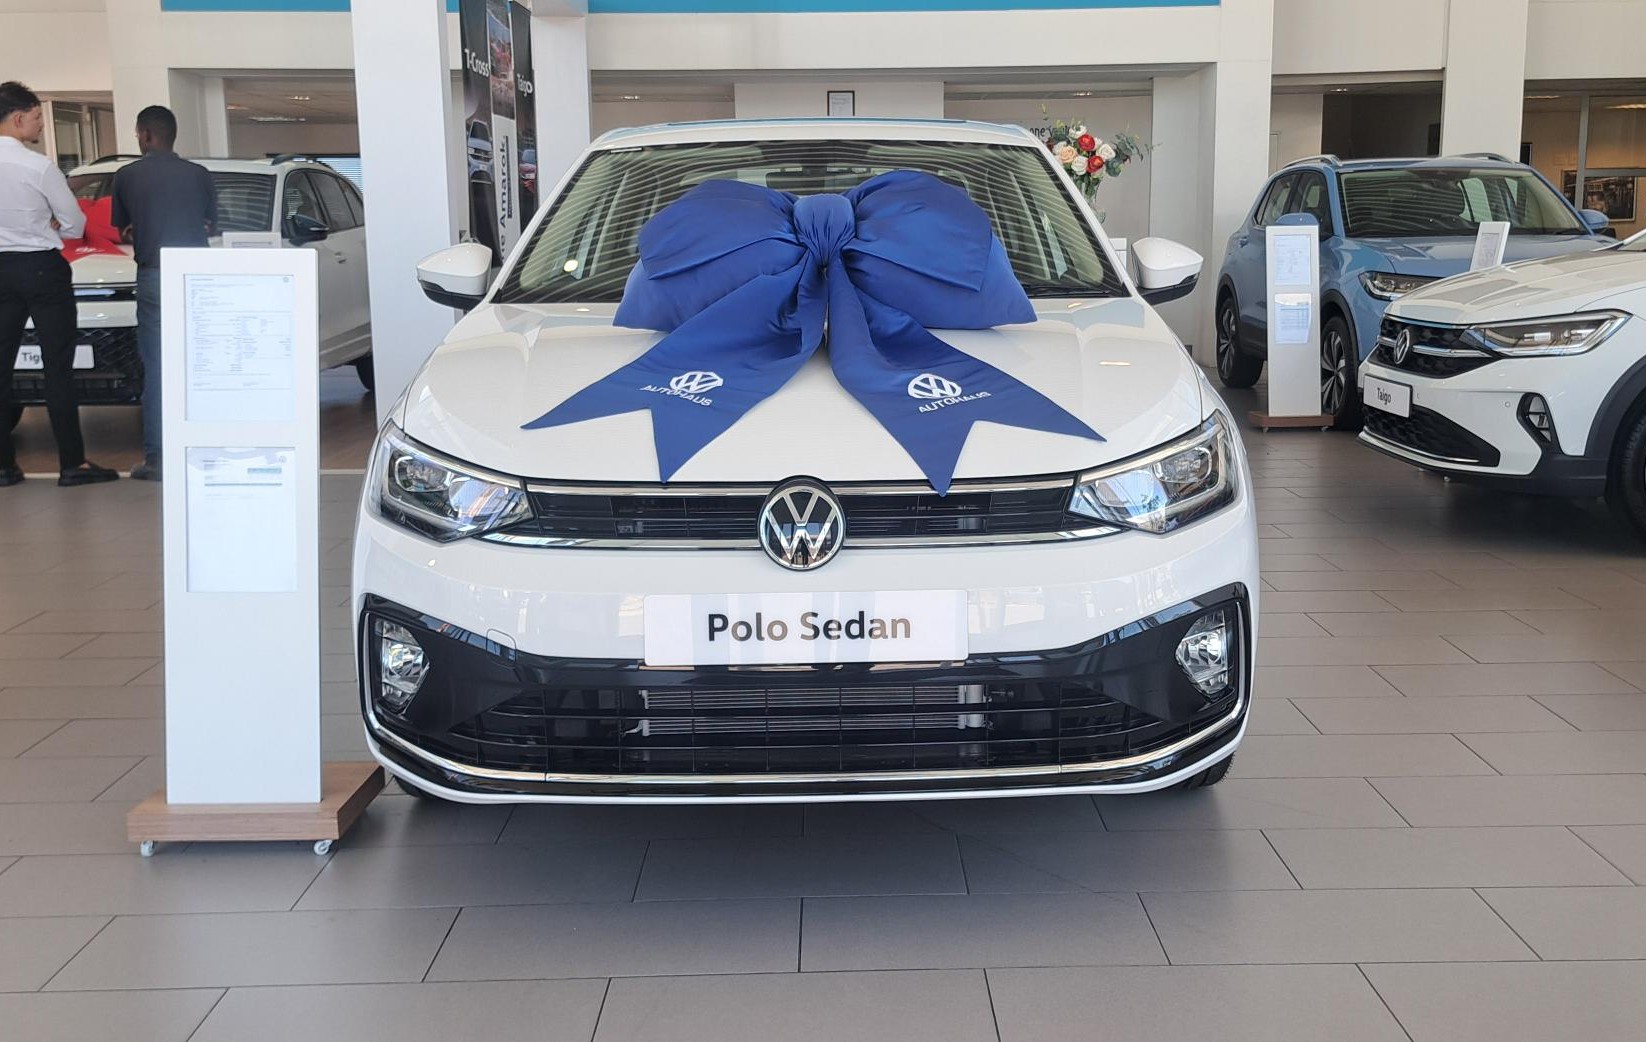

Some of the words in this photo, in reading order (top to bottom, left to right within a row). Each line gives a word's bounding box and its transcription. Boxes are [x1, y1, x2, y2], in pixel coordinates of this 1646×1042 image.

[464, 48, 490, 78] T-Cross
[516, 73, 533, 97] Taigo
[21, 352, 40, 365] Tig
[639, 385, 713, 406] AUTOHAUS
[918, 391, 992, 413] AUTOHAUS
[1377, 387, 1392, 405] Taigo
[708, 612, 788, 642] Polo
[800, 610, 911, 641] Sedan
